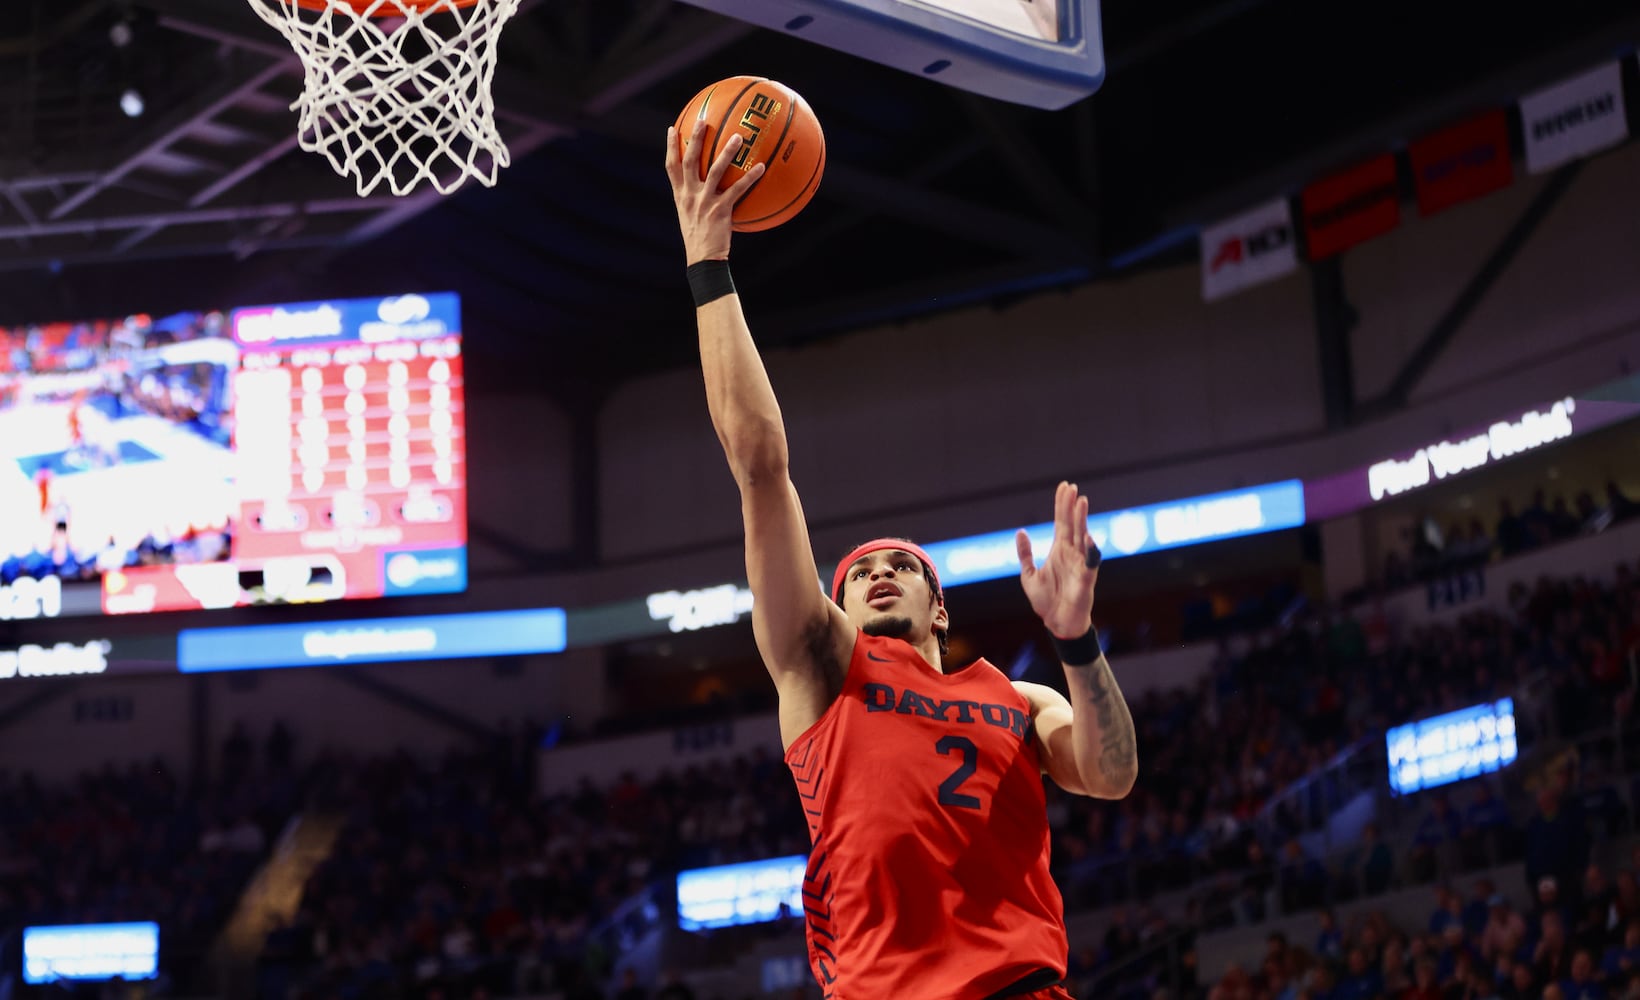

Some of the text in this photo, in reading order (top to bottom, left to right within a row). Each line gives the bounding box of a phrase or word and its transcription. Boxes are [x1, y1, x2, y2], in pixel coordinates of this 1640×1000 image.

[730, 92, 776, 170] ELITE
[1427, 434, 1491, 479] Your
[864, 682, 1033, 745] DAYTON
[935, 735, 981, 810] 2
